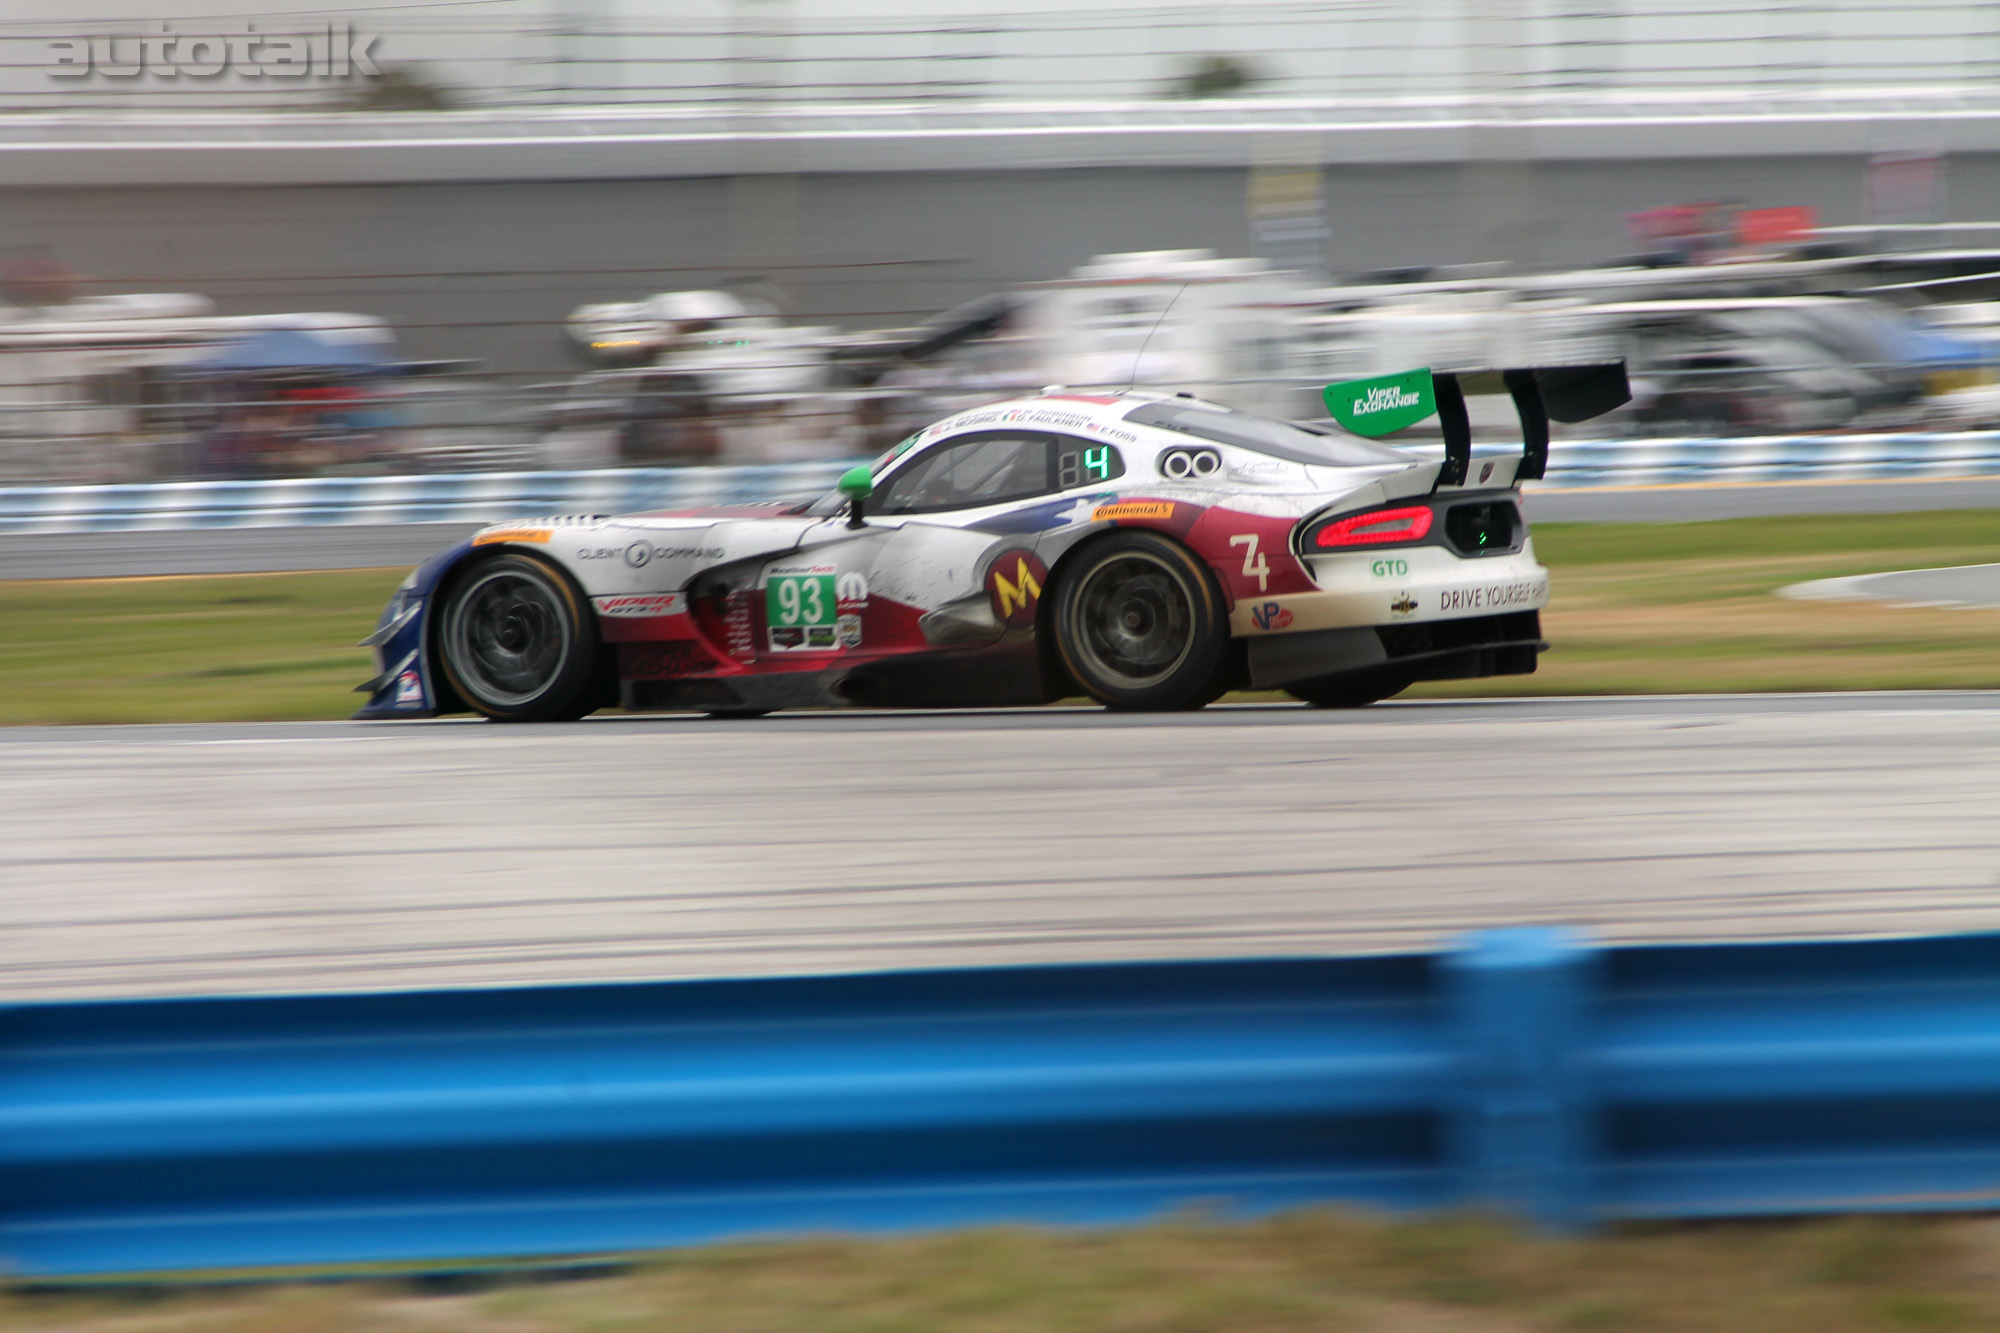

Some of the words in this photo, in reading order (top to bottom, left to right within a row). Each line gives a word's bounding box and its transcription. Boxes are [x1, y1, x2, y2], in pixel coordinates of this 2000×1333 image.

[1353, 392, 1419, 416] EXCHANGE
[1084, 445, 1108, 479] 4
[1096, 504, 1159, 519] Continental
[577, 548, 623, 560] CLIENT
[653, 547, 725, 560] COMMAND
[1372, 559, 1408, 577] GTD
[778, 577, 824, 625] 93
[1440, 587, 1482, 611] DRIVE
[1252, 602, 1281, 630] VP
